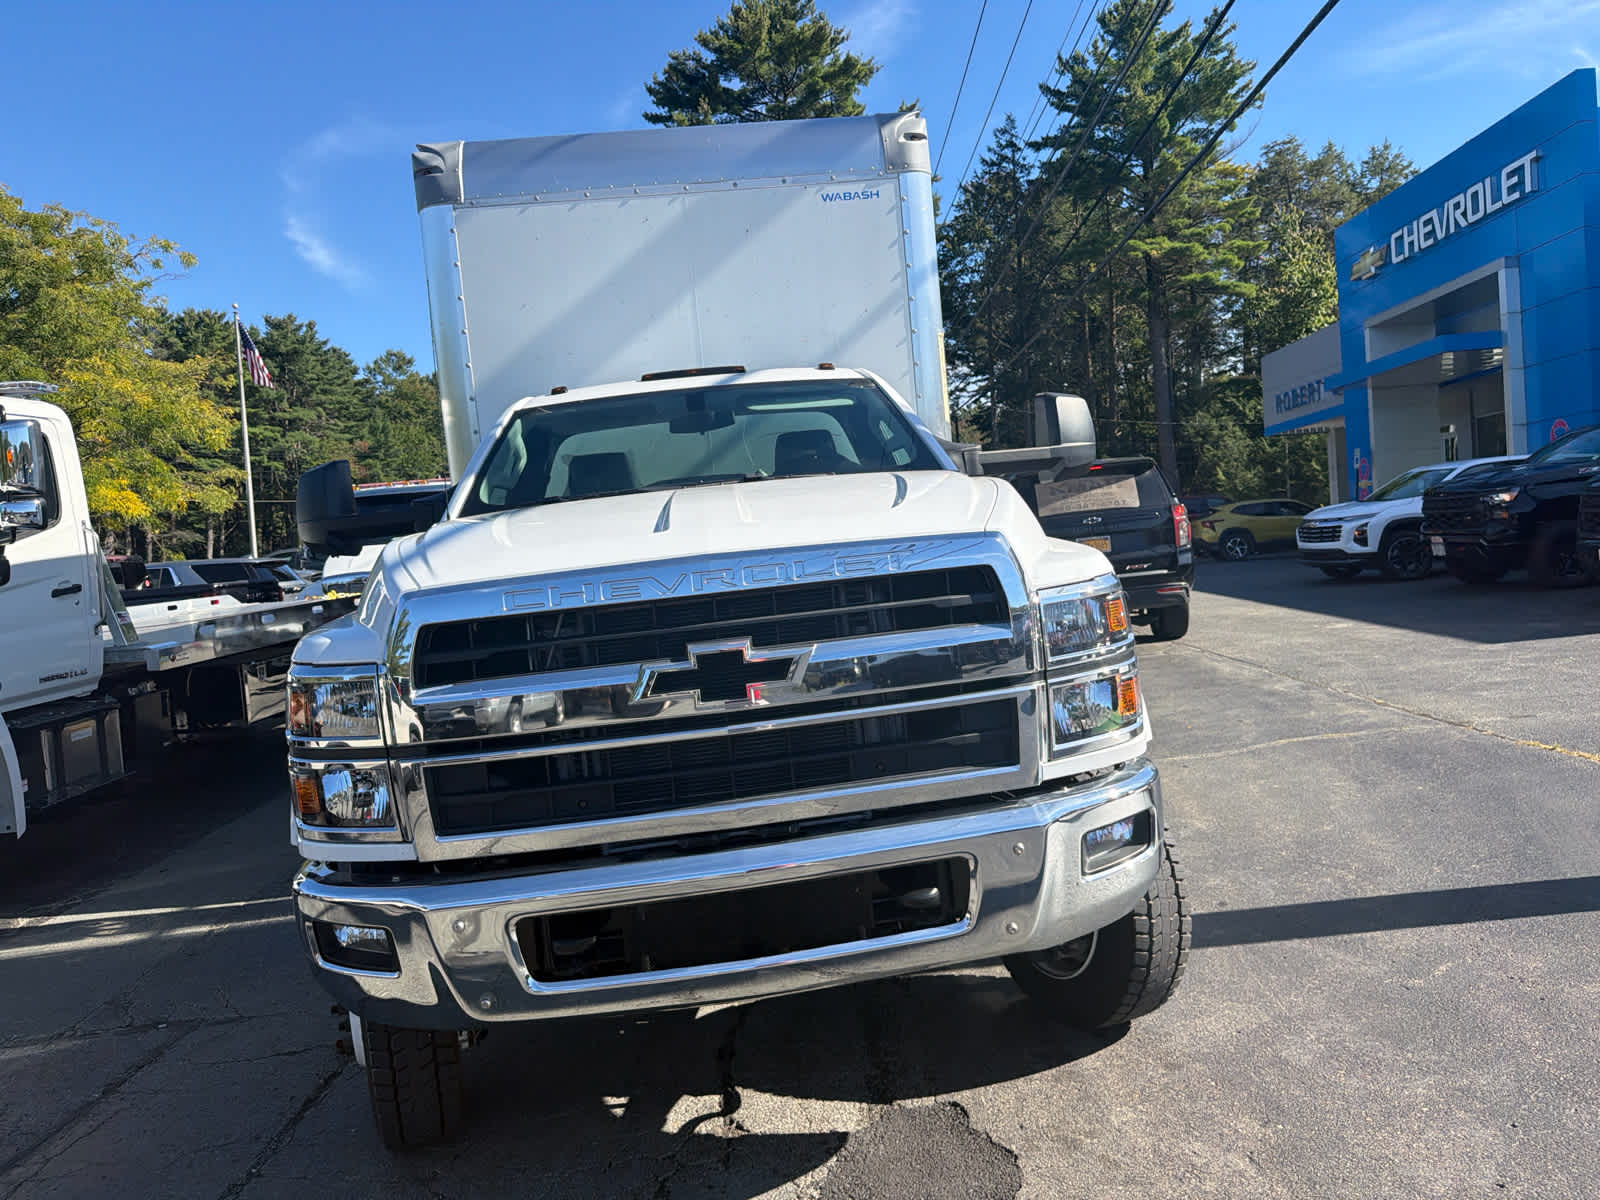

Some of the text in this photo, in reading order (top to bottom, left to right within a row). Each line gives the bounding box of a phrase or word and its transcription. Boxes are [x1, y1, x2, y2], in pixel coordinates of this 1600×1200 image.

[820, 189, 880, 202] WABASH
[1389, 150, 1539, 265] CHEVROLET
[1275, 379, 1325, 415] ROBERT
[502, 549, 914, 611] CHEVROLET
